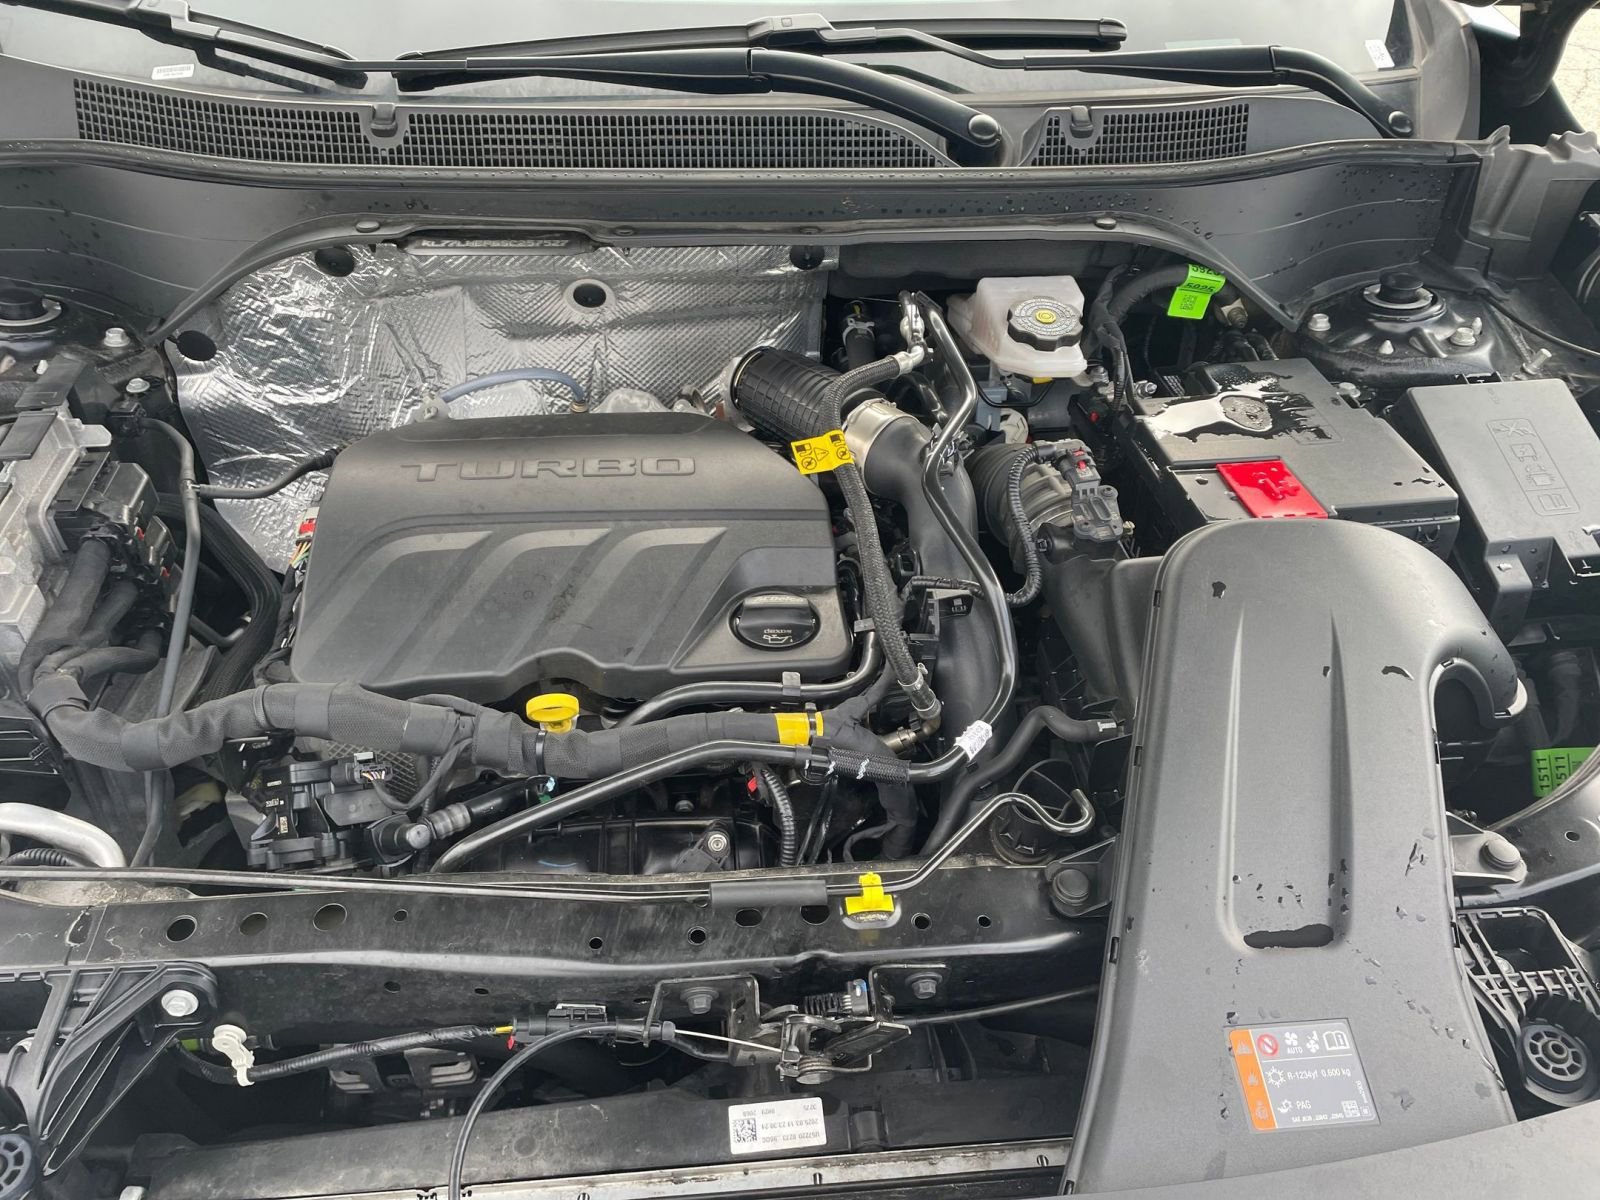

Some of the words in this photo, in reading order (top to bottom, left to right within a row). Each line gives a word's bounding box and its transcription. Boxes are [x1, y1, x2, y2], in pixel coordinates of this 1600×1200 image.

[400, 457, 696, 482] TURBO
[1536, 758, 1550, 790] 1511
[1555, 756, 1568, 786] 511
[1286, 1046, 1303, 1055] AUTO
[1287, 1070, 1319, 1081] R-1234yf
[1341, 1068, 1351, 1078] kg
[1296, 1100, 1312, 1110] PAG
